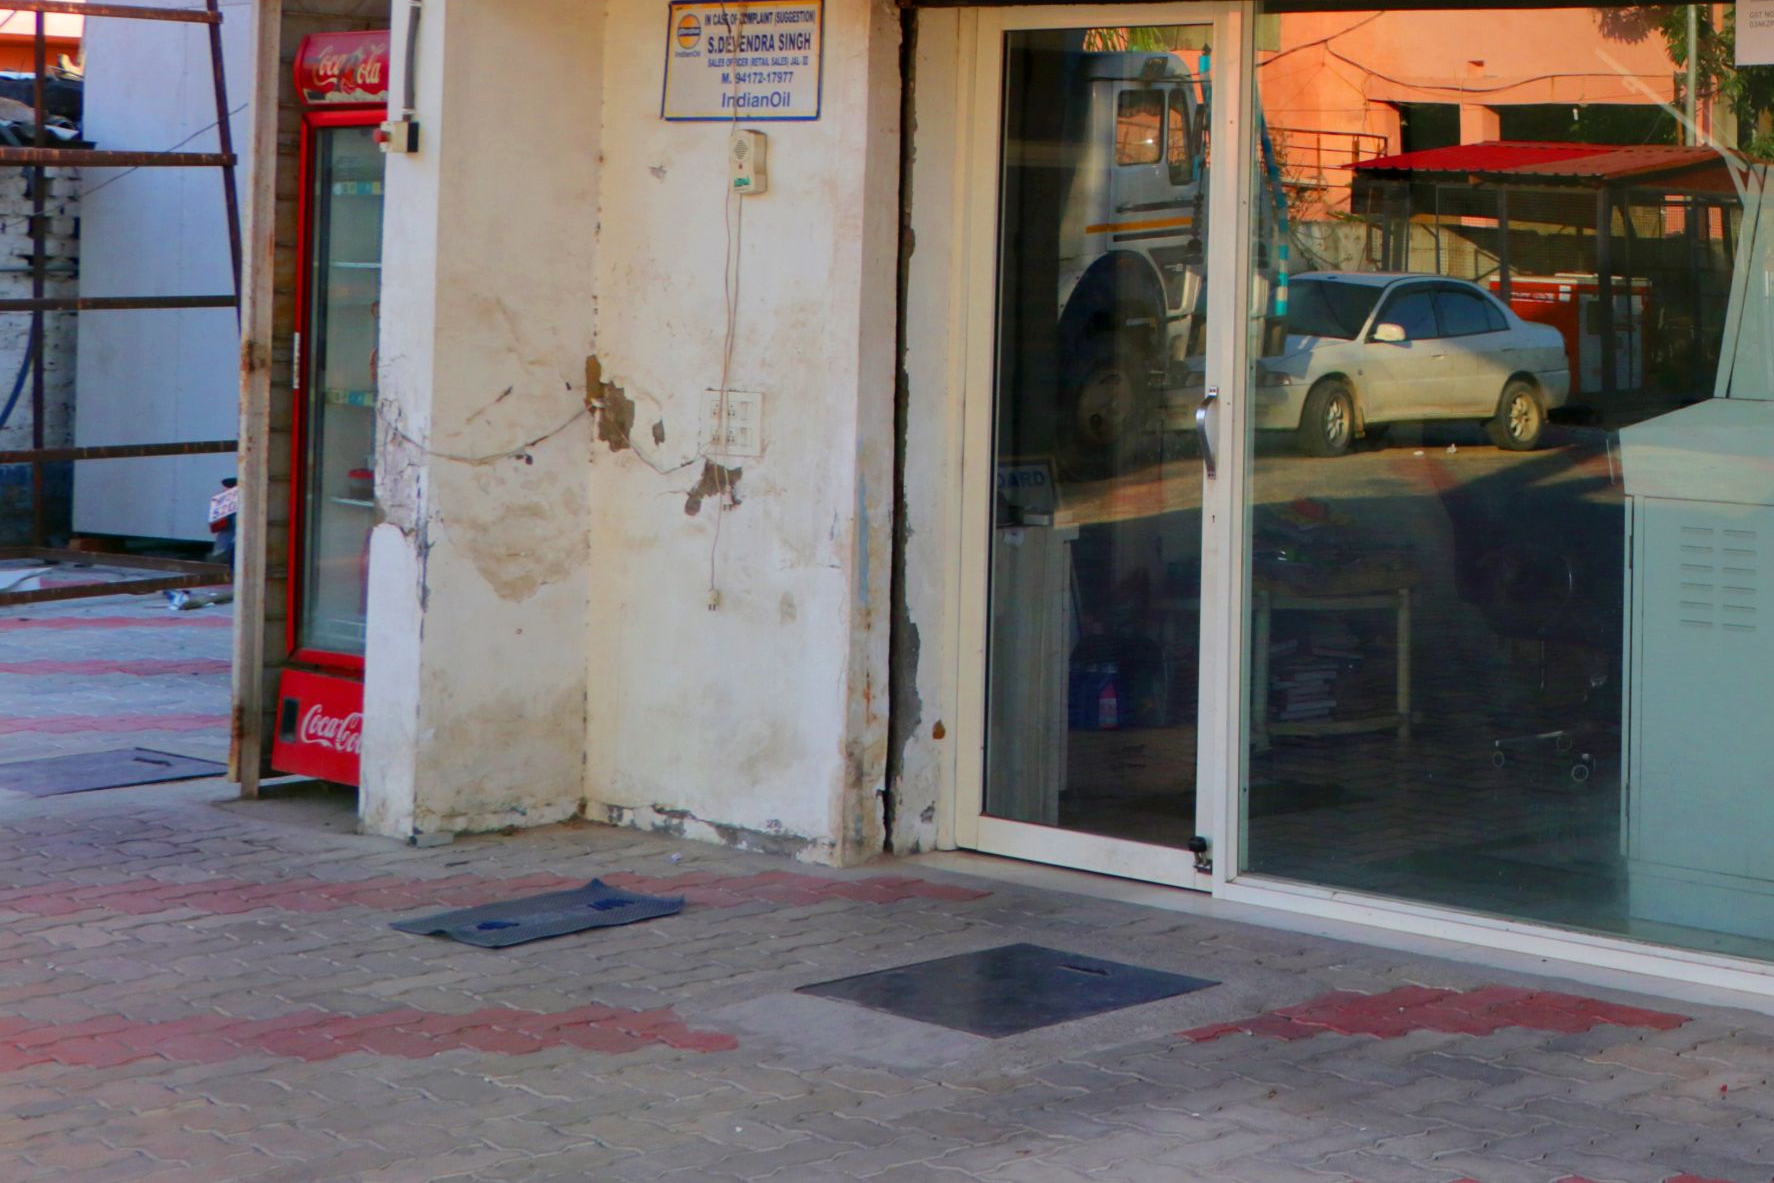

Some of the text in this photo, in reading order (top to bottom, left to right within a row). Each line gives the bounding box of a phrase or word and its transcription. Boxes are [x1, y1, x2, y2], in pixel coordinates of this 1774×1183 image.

[704, 14, 712, 26] IN
[712, 13, 728, 26] CASE
[730, 13, 738, 25] OF
[778, 32, 812, 52] SINGH
[721, 70, 794, 84] M. 94172-17977
[721, 90, 791, 109] IndianOil
